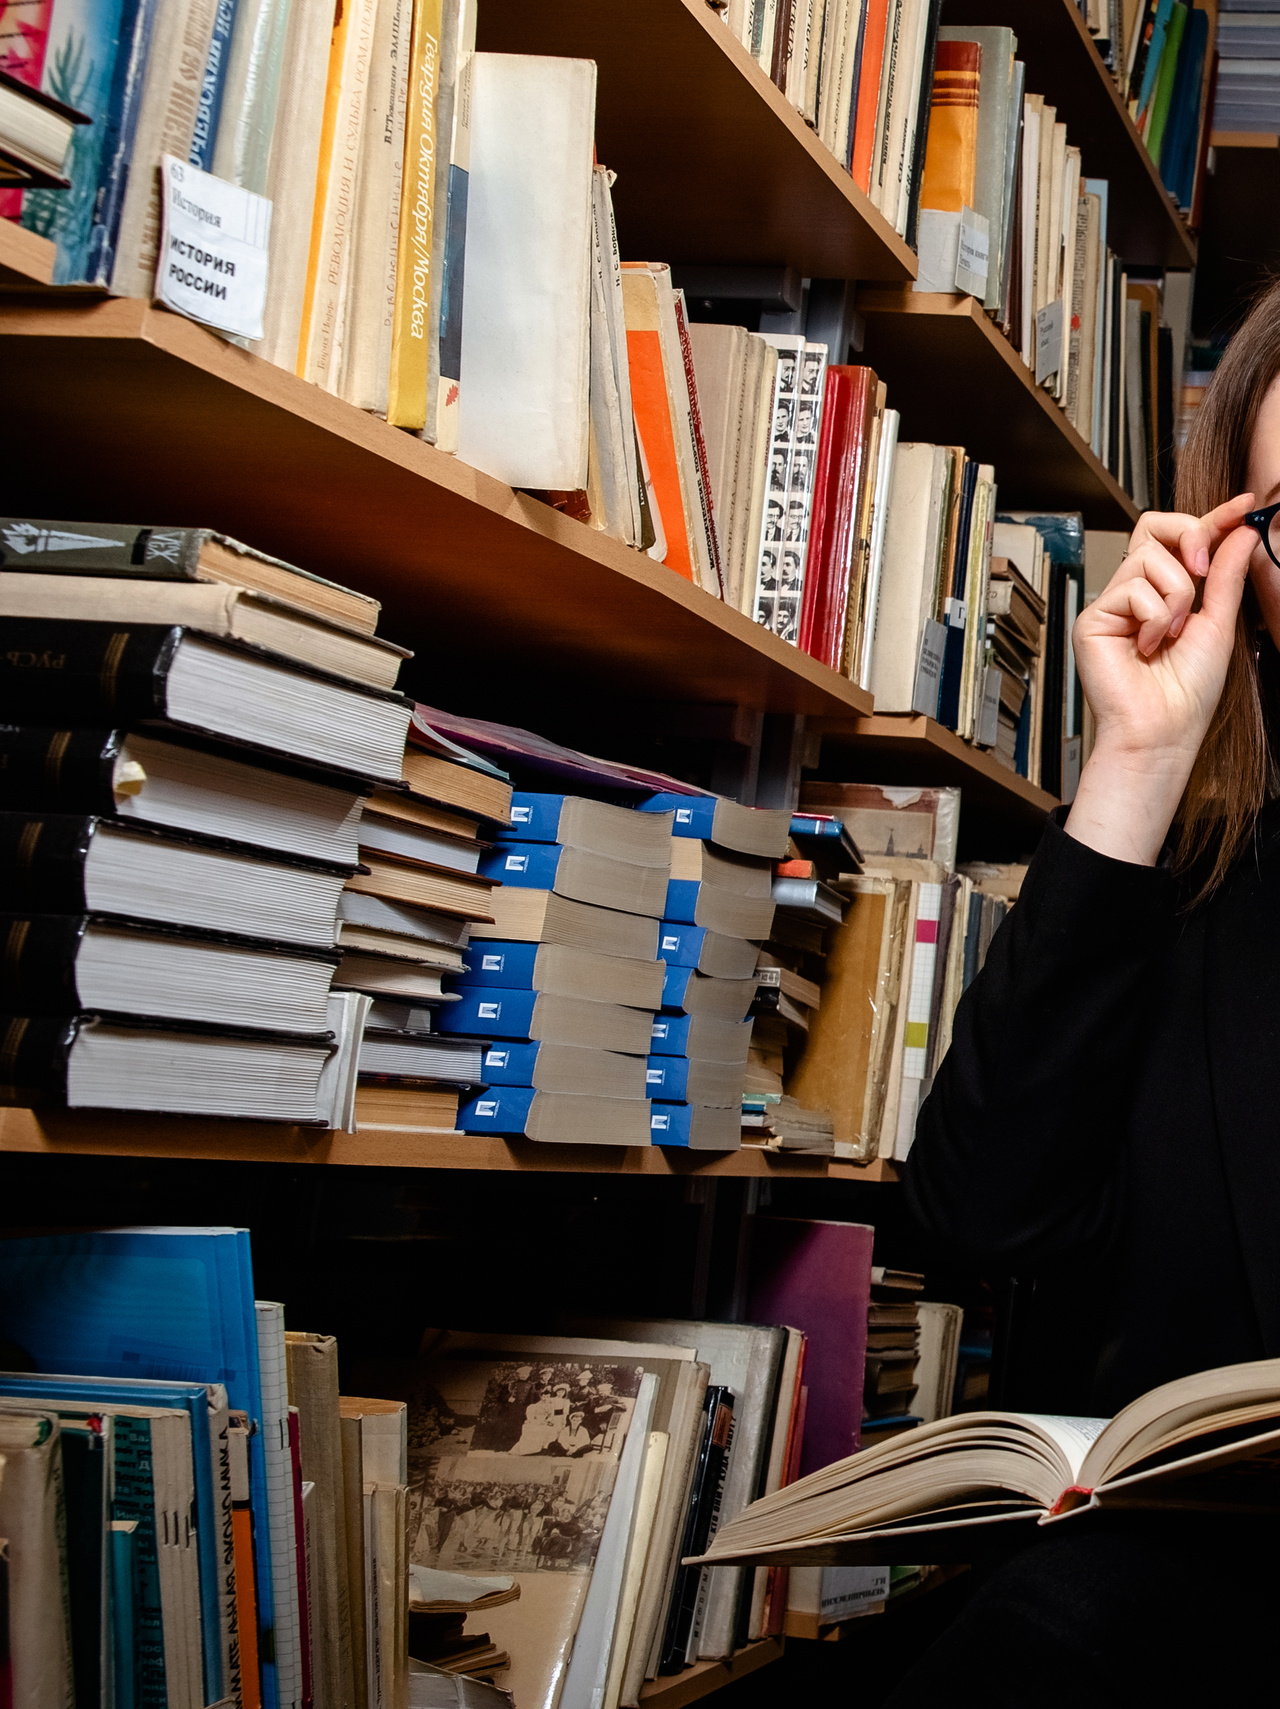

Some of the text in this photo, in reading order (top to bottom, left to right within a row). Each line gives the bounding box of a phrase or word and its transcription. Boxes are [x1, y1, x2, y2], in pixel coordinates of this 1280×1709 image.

[343, 88, 365, 151] СУДЬБА
[342, 155, 354, 170] И
[409, 30, 439, 340] Гвардия Октября/Москва
[172, 187, 222, 229] История
[326, 176, 352, 285] РЕВОЛЮЦИЯ
[168, 263, 228, 300] РОССИИ
[170, 234, 236, 277] ИСТОРИЯ
[686, 410, 700, 474] ПОРТРЕТЫ
[146, 531, 186, 564] ЖЗЛ
[696, 478, 715, 570] ИСТОРИЧЕСКИЕ
[708, 1515, 718, 1533] КТО
[717, 1455, 729, 1481] КУДА
